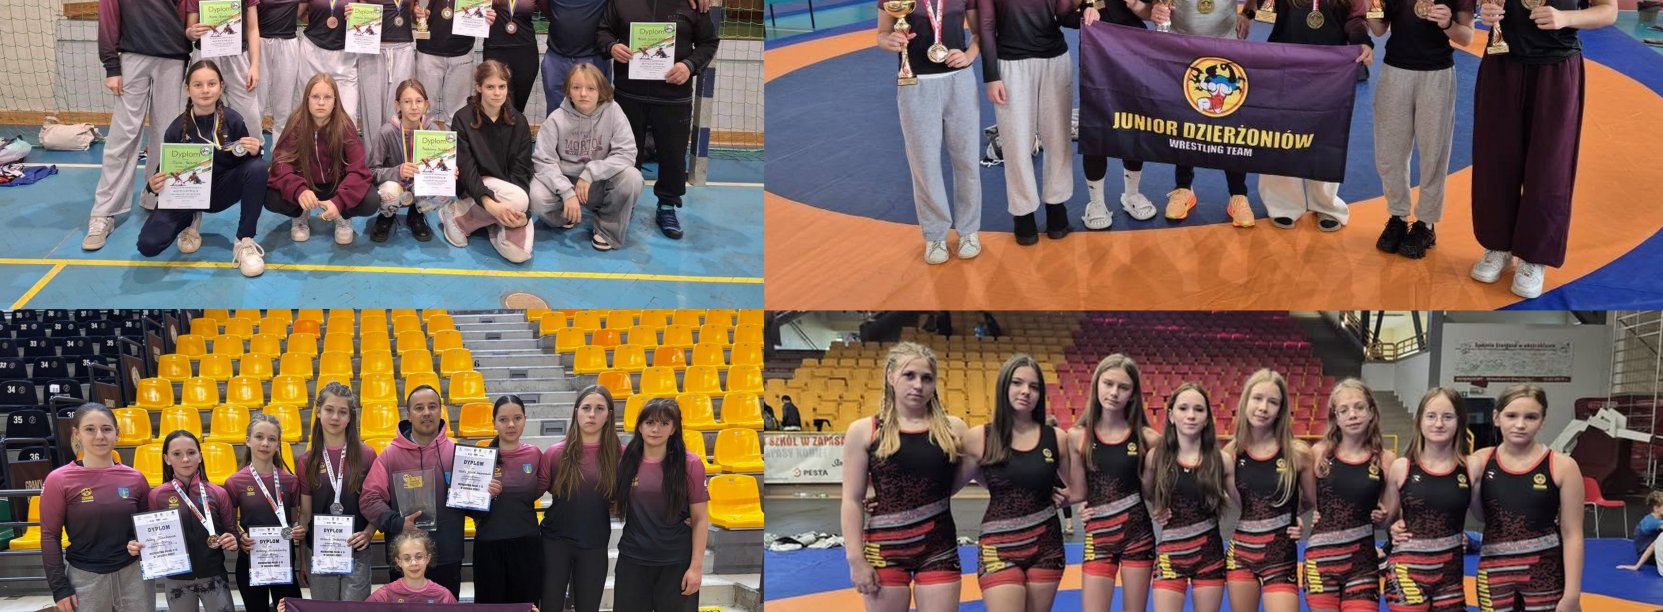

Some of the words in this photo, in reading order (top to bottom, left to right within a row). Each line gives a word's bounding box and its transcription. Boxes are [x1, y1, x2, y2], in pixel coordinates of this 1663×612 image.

[1112, 111, 1178, 137] JUNIOR
[1183, 121, 1315, 150] DZIERŻONIÓW
[422, 137, 447, 145] Dyplom
[1169, 138, 1224, 155] WRESTLING
[1226, 146, 1253, 157] TEAM
[171, 150, 201, 158] Dyplom
[474, 360, 480, 368] 6
[7, 385, 16, 393] 34
[13, 415, 23, 424] 35
[147, 524, 171, 532] DYPLOM
